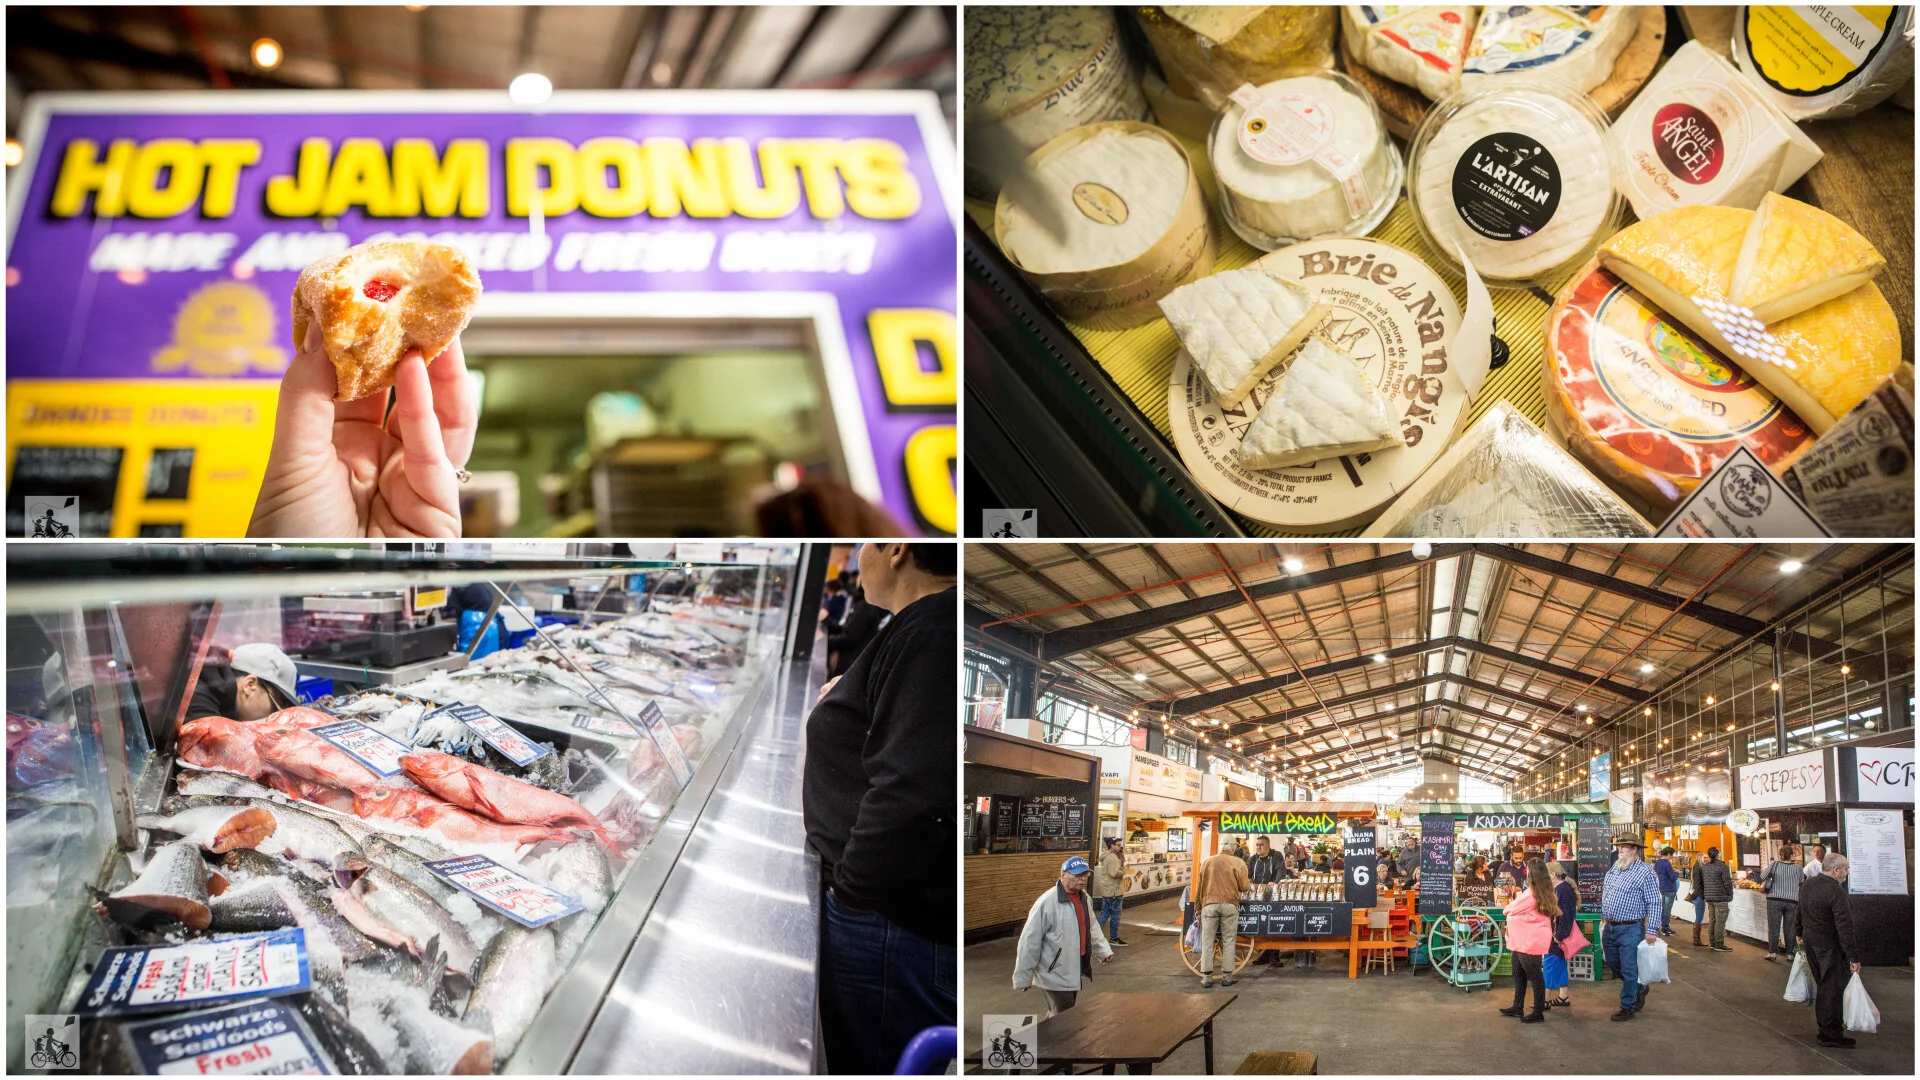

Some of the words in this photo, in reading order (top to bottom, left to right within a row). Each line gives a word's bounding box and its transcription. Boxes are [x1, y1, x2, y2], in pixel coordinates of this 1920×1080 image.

[1808, 5, 1832, 23] IPLE
[1830, 17, 1865, 50] CREAM
[1680, 116, 1715, 158] Saint
[1657, 115, 1711, 181] ANGEL
[50, 137, 262, 218] HOT
[266, 137, 490, 218] JAM
[506, 136, 922, 219] DONUTS
[1471, 152, 1550, 205] L'ARTISAN
[1478, 182, 1522, 211] EXTRAVAGANT
[1493, 182, 1516, 198] organic
[1298, 250, 1397, 286] Brie
[1388, 282, 1416, 301] de
[1363, 297, 1373, 306] au
[1375, 303, 1388, 317] lait
[1366, 310, 1378, 321] en
[1377, 320, 1392, 345] Seine
[1386, 316, 1402, 344] nature
[1388, 347, 1396, 357] et
[1400, 346, 1408, 360] de
[1398, 361, 1408, 371] la
[1614, 337, 1686, 411] ENSEN'S
[1382, 359, 1397, 393] Marne
[1264, 469, 1283, 481] CHEESE
[1282, 471, 1306, 483] PRODUCT
[1305, 474, 1313, 483] OF
[1312, 473, 1333, 483] FRANCE
[1269, 481, 1285, 492] TOTAL
[1285, 485, 1296, 493] FAT
[1134, 754, 1160, 768] HAMBURGER
[1750, 765, 1808, 796] CREPES
[1042, 796, 1067, 804] BURGERS
[1221, 812, 1282, 833] BANANA
[1474, 815, 1516, 828] KADAK
[1517, 815, 1552, 828] CHAI
[1422, 836, 1453, 844] KASHMIRI
[1344, 848, 1375, 857] PLAIN
[433, 857, 486, 870] Schwarze
[445, 861, 495, 874] Seafoods
[462, 869, 496, 881] Fresh
[1460, 885, 1494, 893] LEMONADE
[1280, 904, 1305, 912] AVOUR
[88, 952, 127, 1007] Schwarze
[111, 950, 145, 1001] Seafoods
[137, 960, 165, 991] Fresh
[149, 1006, 278, 1046] Schwarze
[164, 1019, 288, 1061] Seafoods
[195, 1042, 273, 1074] Fresh
